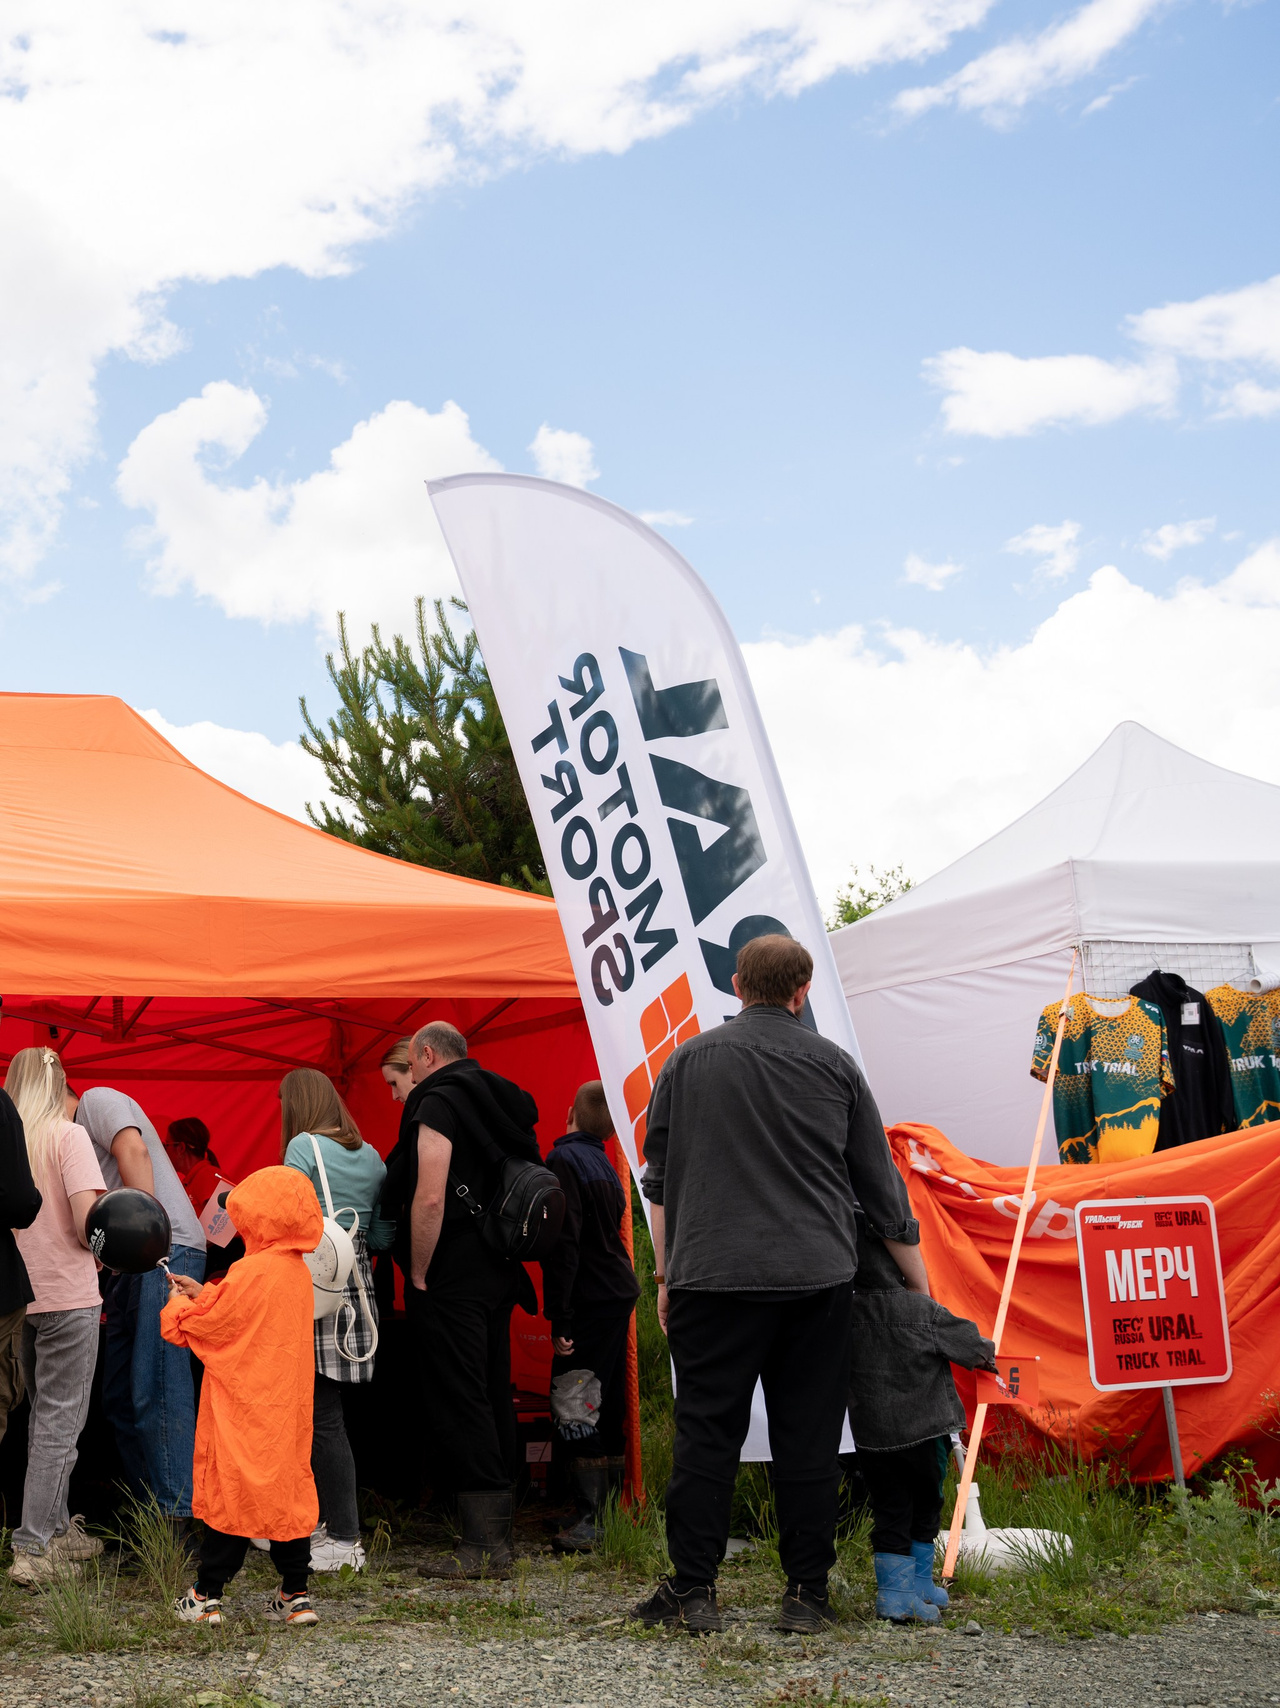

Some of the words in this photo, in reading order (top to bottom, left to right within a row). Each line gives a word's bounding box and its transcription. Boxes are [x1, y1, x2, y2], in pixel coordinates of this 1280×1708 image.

[1102, 1061, 1140, 1076] TRIAL
[1118, 1220, 1144, 1229] РУБЕЖ
[1175, 1210, 1207, 1226] URAL
[1105, 1245, 1199, 1303] МЕРЧ
[1148, 1313, 1203, 1341] URAL
[1114, 1332, 1145, 1345] RUSSIA
[1116, 1351, 1160, 1370] TRUCK
[1166, 1348, 1206, 1367] TRIAL
